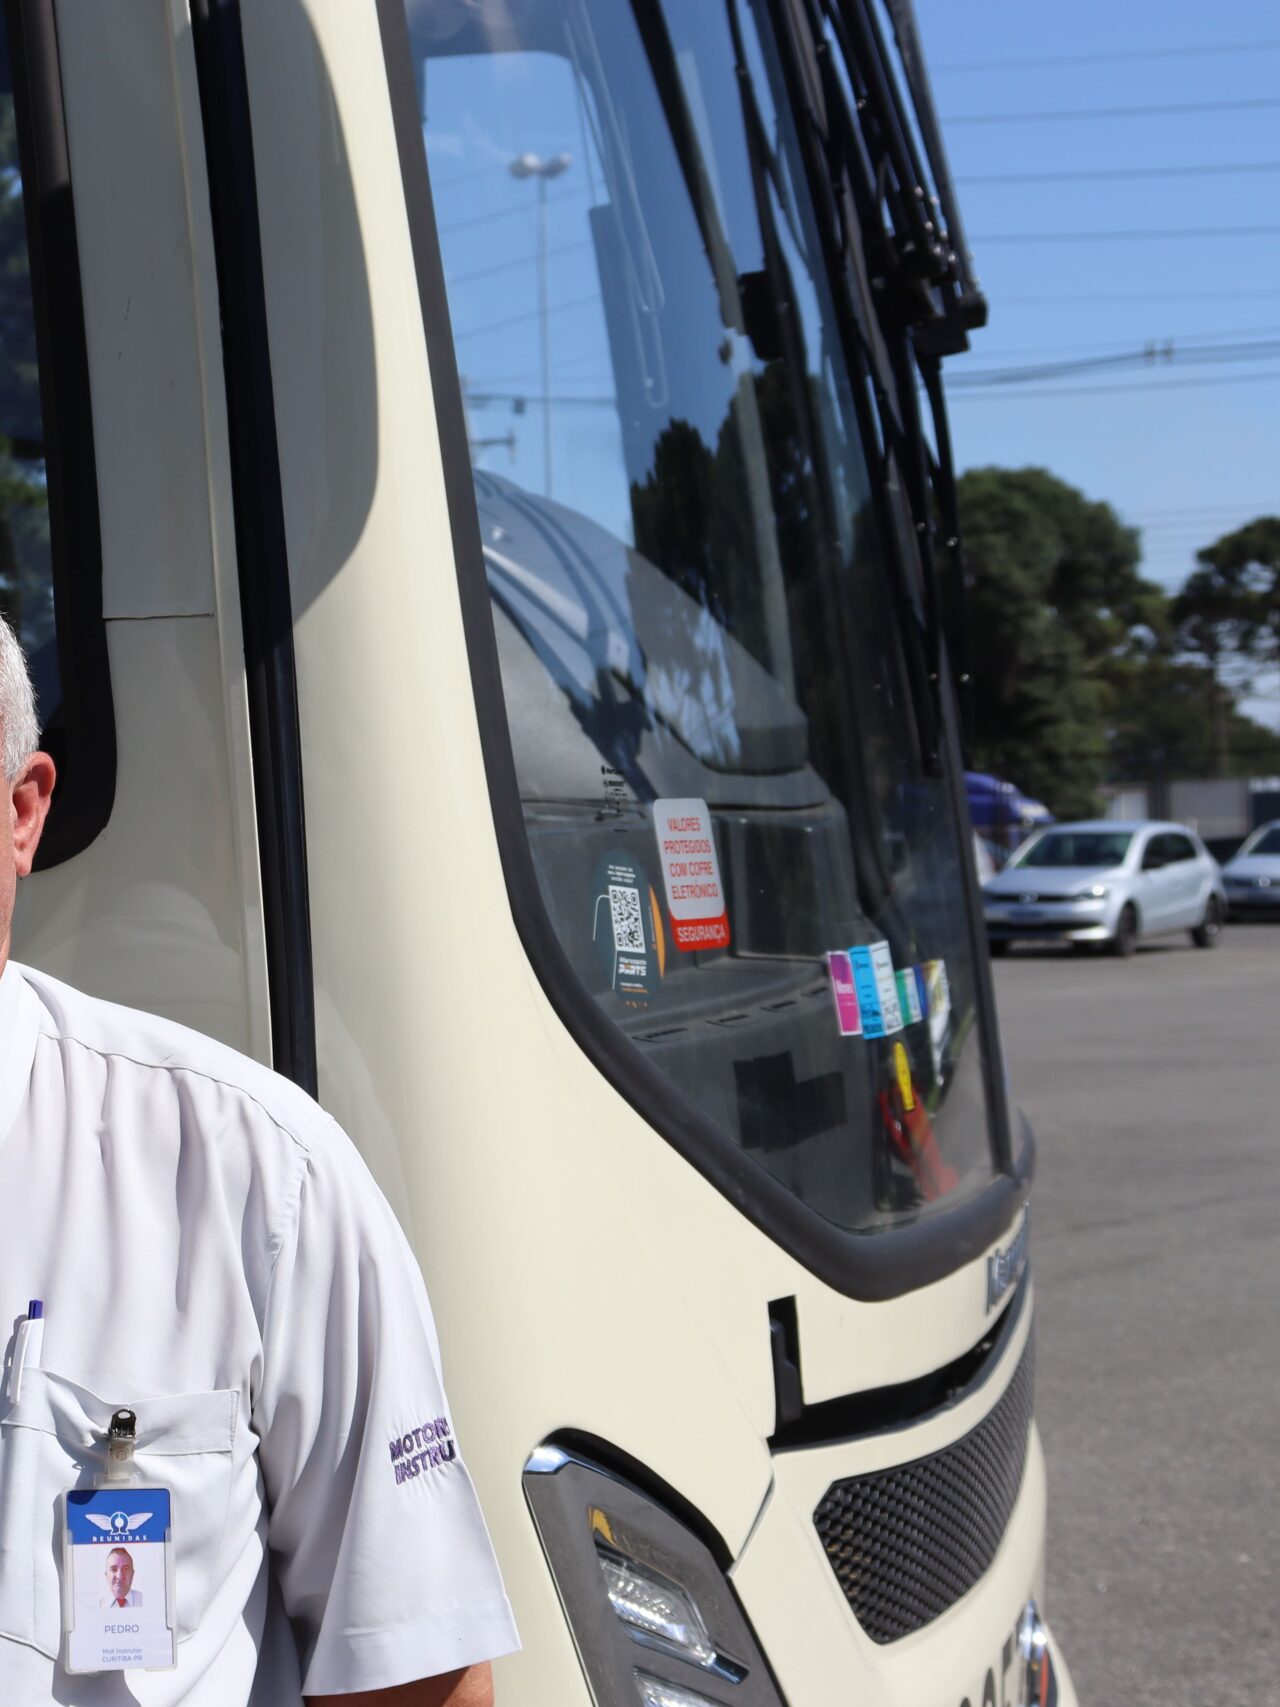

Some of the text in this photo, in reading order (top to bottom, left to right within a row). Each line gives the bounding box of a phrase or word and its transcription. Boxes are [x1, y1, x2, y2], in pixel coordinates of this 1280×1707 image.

[667, 817, 701, 832] VALORES
[664, 839, 712, 854] PROTEGIDOS
[670, 861, 714, 877] COM COFRE
[92, 1534, 148, 1543] REUNIDAS
[104, 1624, 140, 1634] PEDRO
